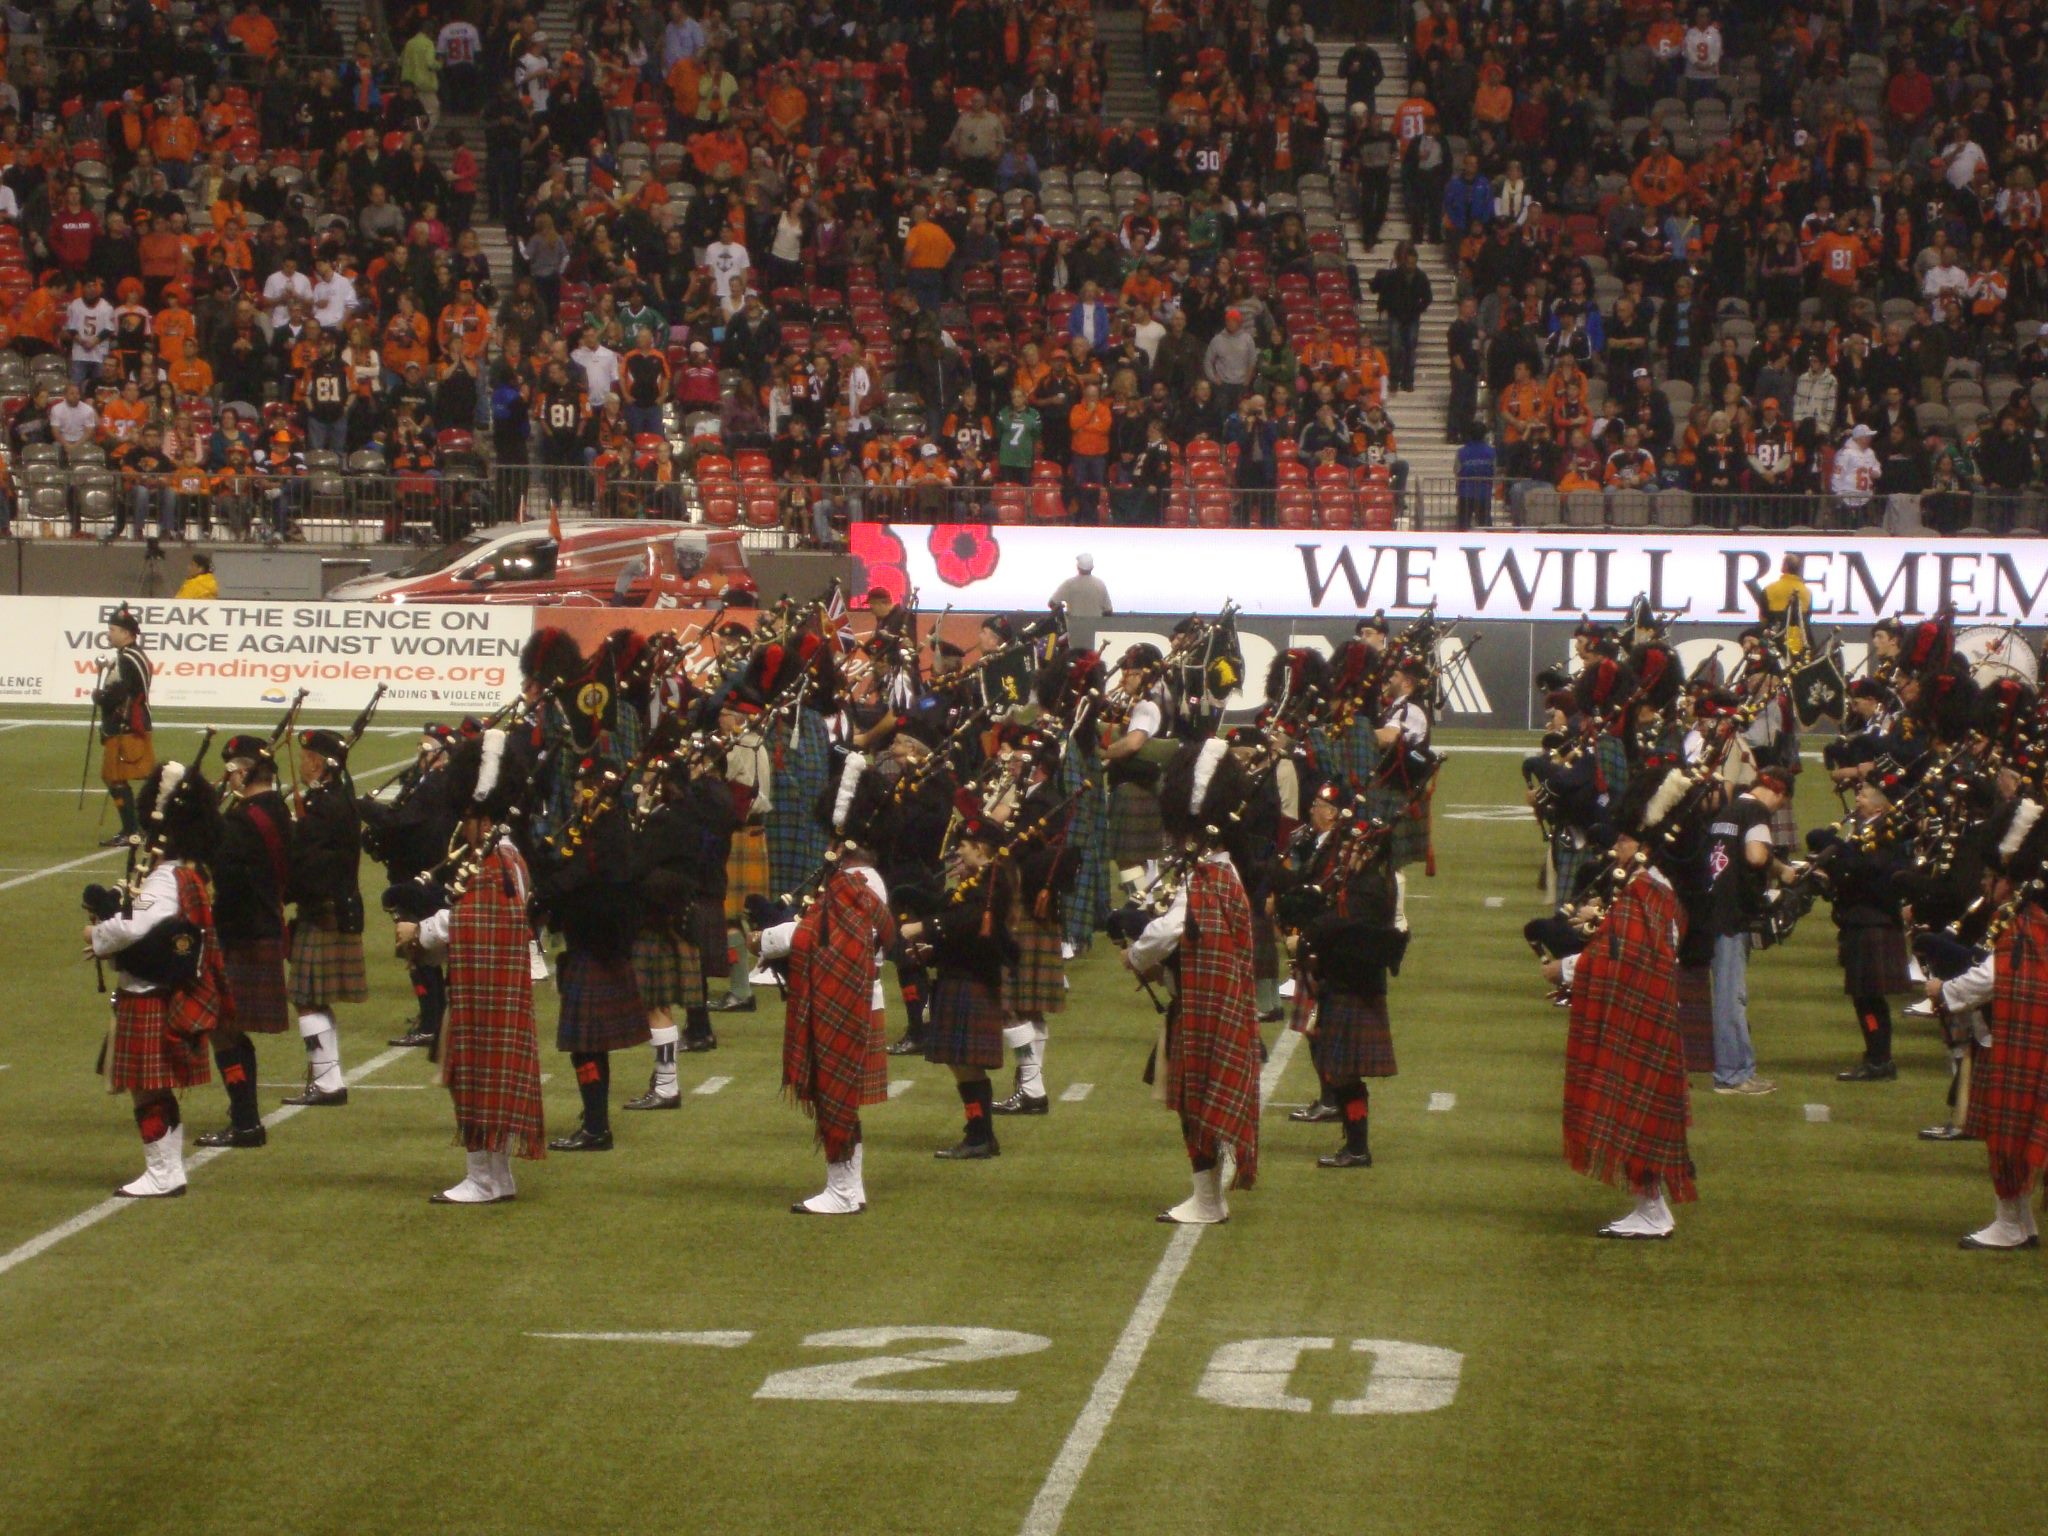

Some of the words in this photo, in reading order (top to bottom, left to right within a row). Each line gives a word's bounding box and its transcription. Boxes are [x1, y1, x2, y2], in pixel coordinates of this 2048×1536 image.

[1402, 113, 1424, 139] 81
[1196, 150, 1220, 171] 30
[1832, 249, 1852, 271] 81
[83, 316, 97, 336] 5
[316, 376, 340, 401] 81
[550, 404, 575, 428] 81
[1010, 423, 1025, 446] 7
[1758, 444, 1781, 467] 81
[1295, 544, 1438, 610] WE
[1460, 546, 1692, 613] WILL
[220, 607, 283, 628] THE
[293, 608, 431, 630] SILENCE
[441, 611, 490, 631] ON
[64, 630, 228, 653] VIOENCE
[237, 633, 382, 655] AGAINST
[391, 637, 521, 657] WOMEN
[74, 658, 505, 687] ww.endingviolence.org
[443, 690, 501, 701] VIOLENCE
